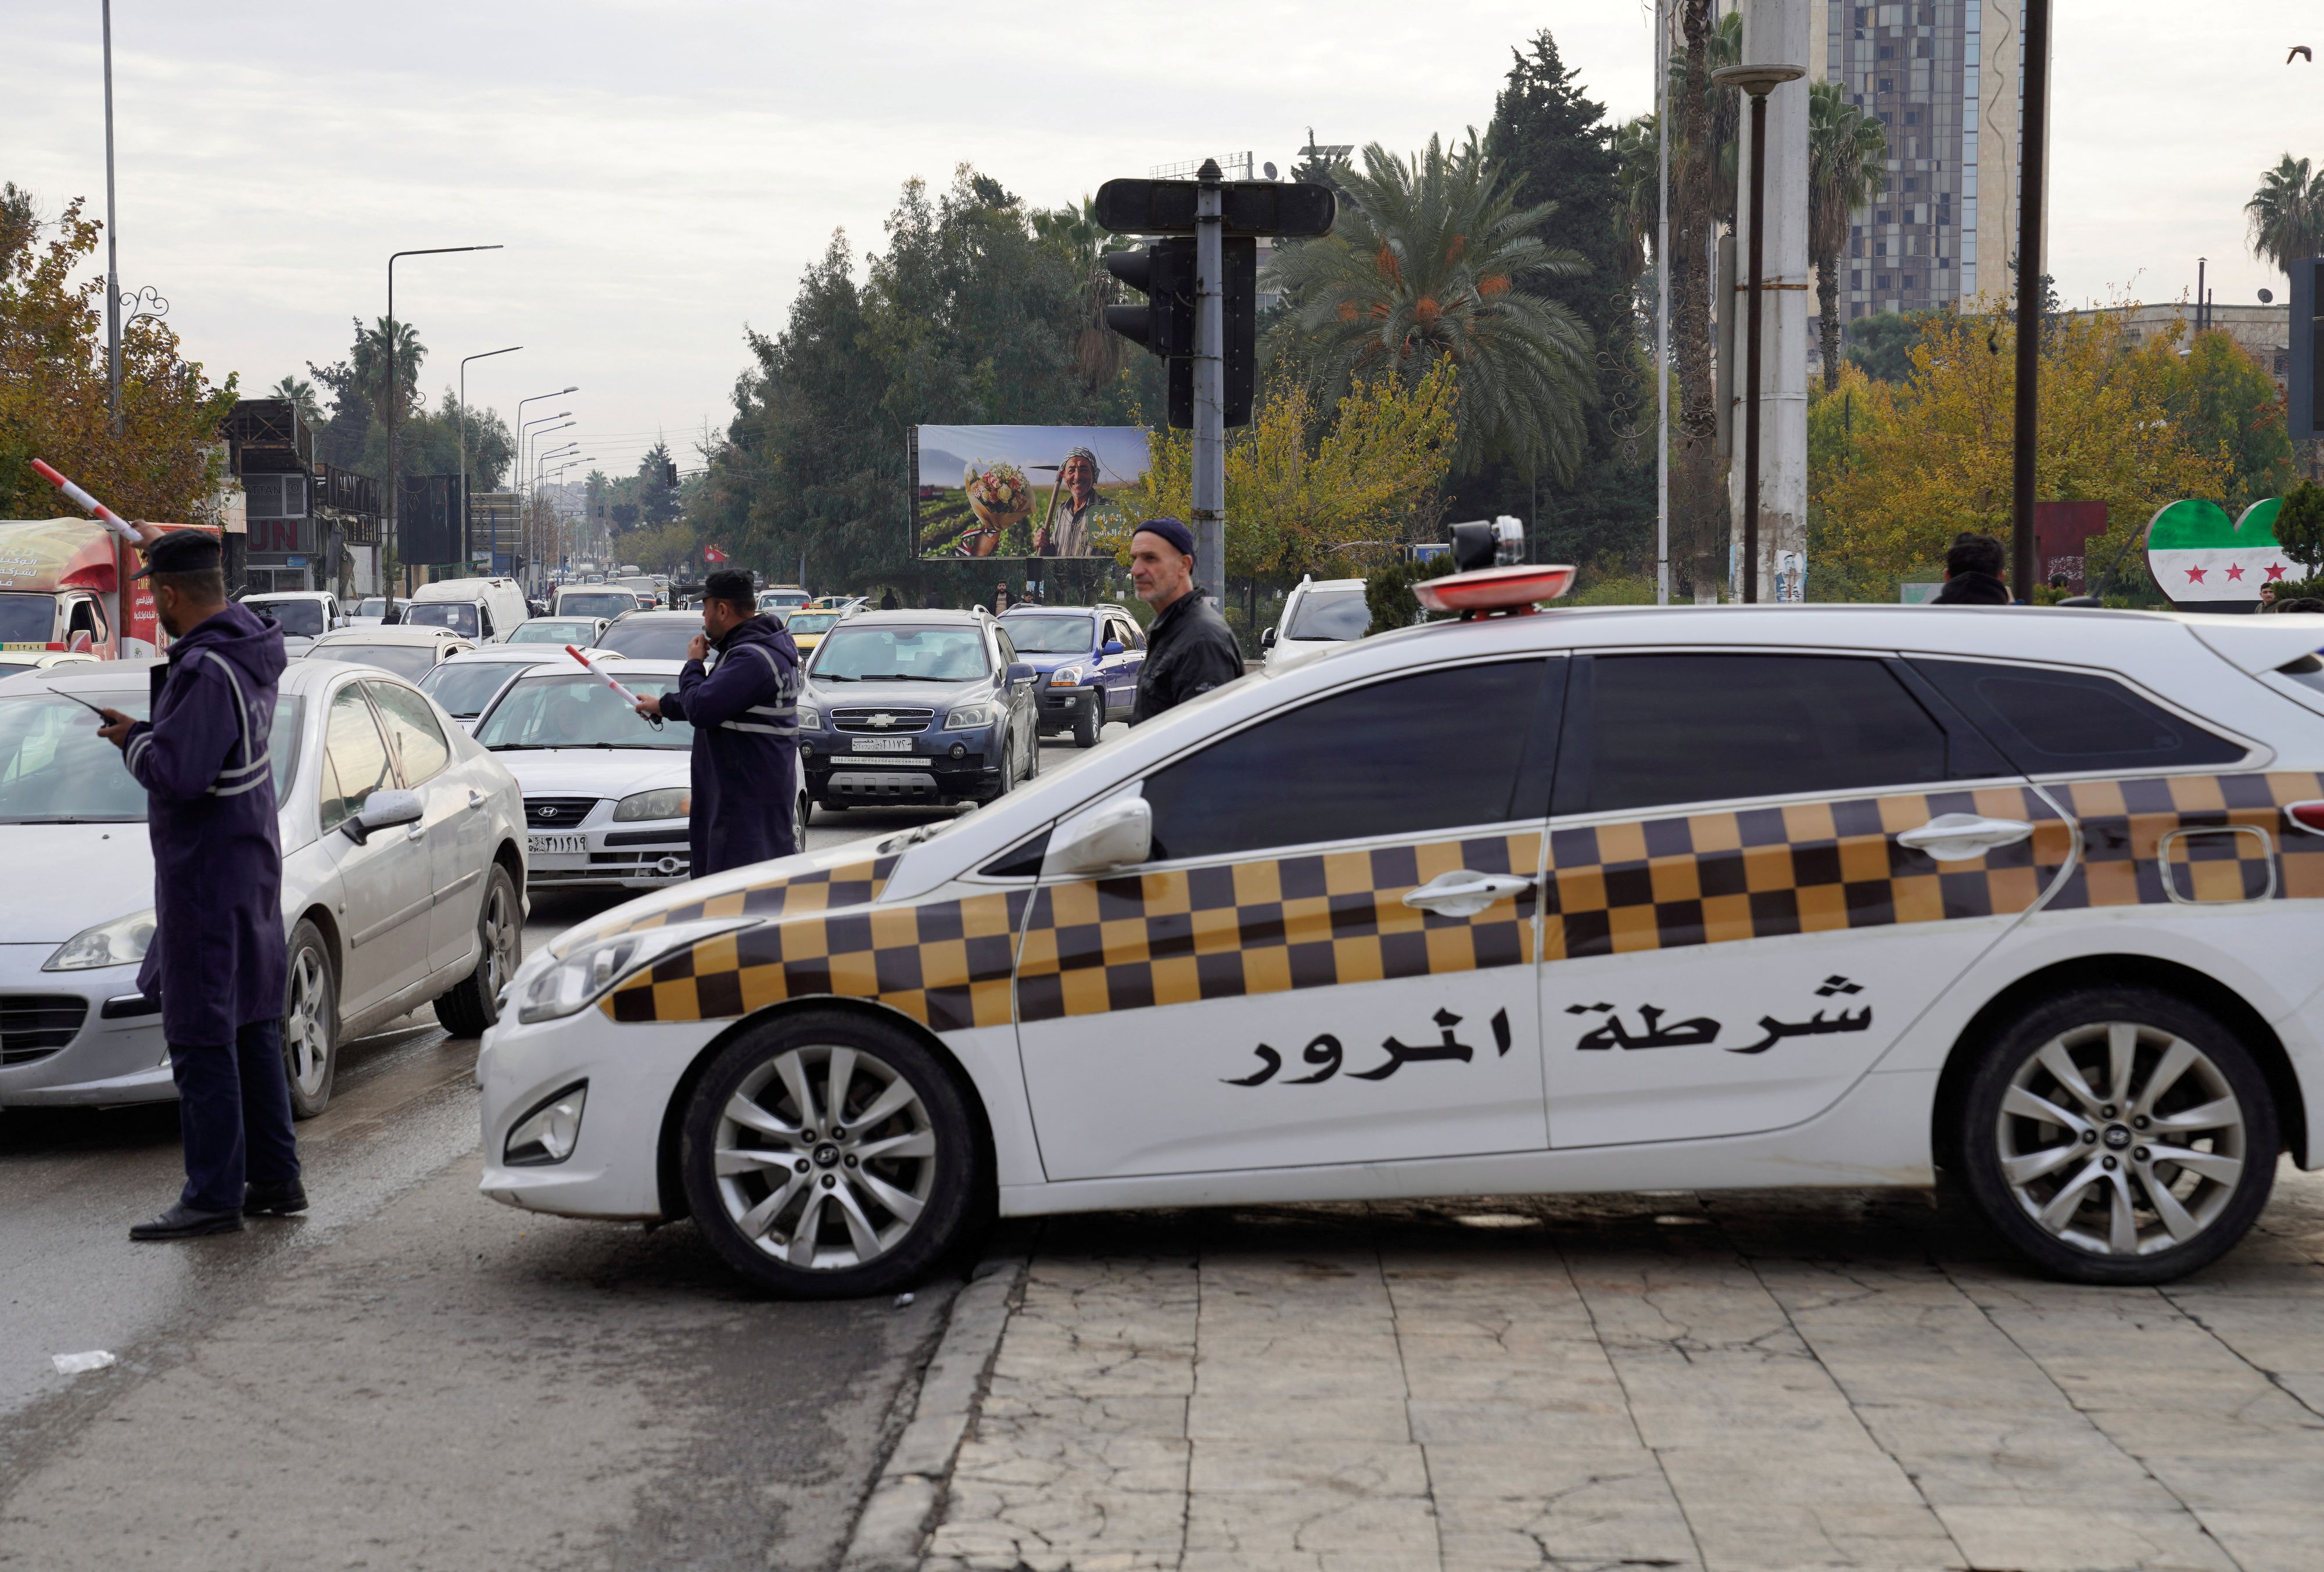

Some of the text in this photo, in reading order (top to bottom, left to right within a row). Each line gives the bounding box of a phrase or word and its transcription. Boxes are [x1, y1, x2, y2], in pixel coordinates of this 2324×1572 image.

[0, 567, 38, 577] لشركة
[1219, 975, 1873, 1087] شرطة المرور
